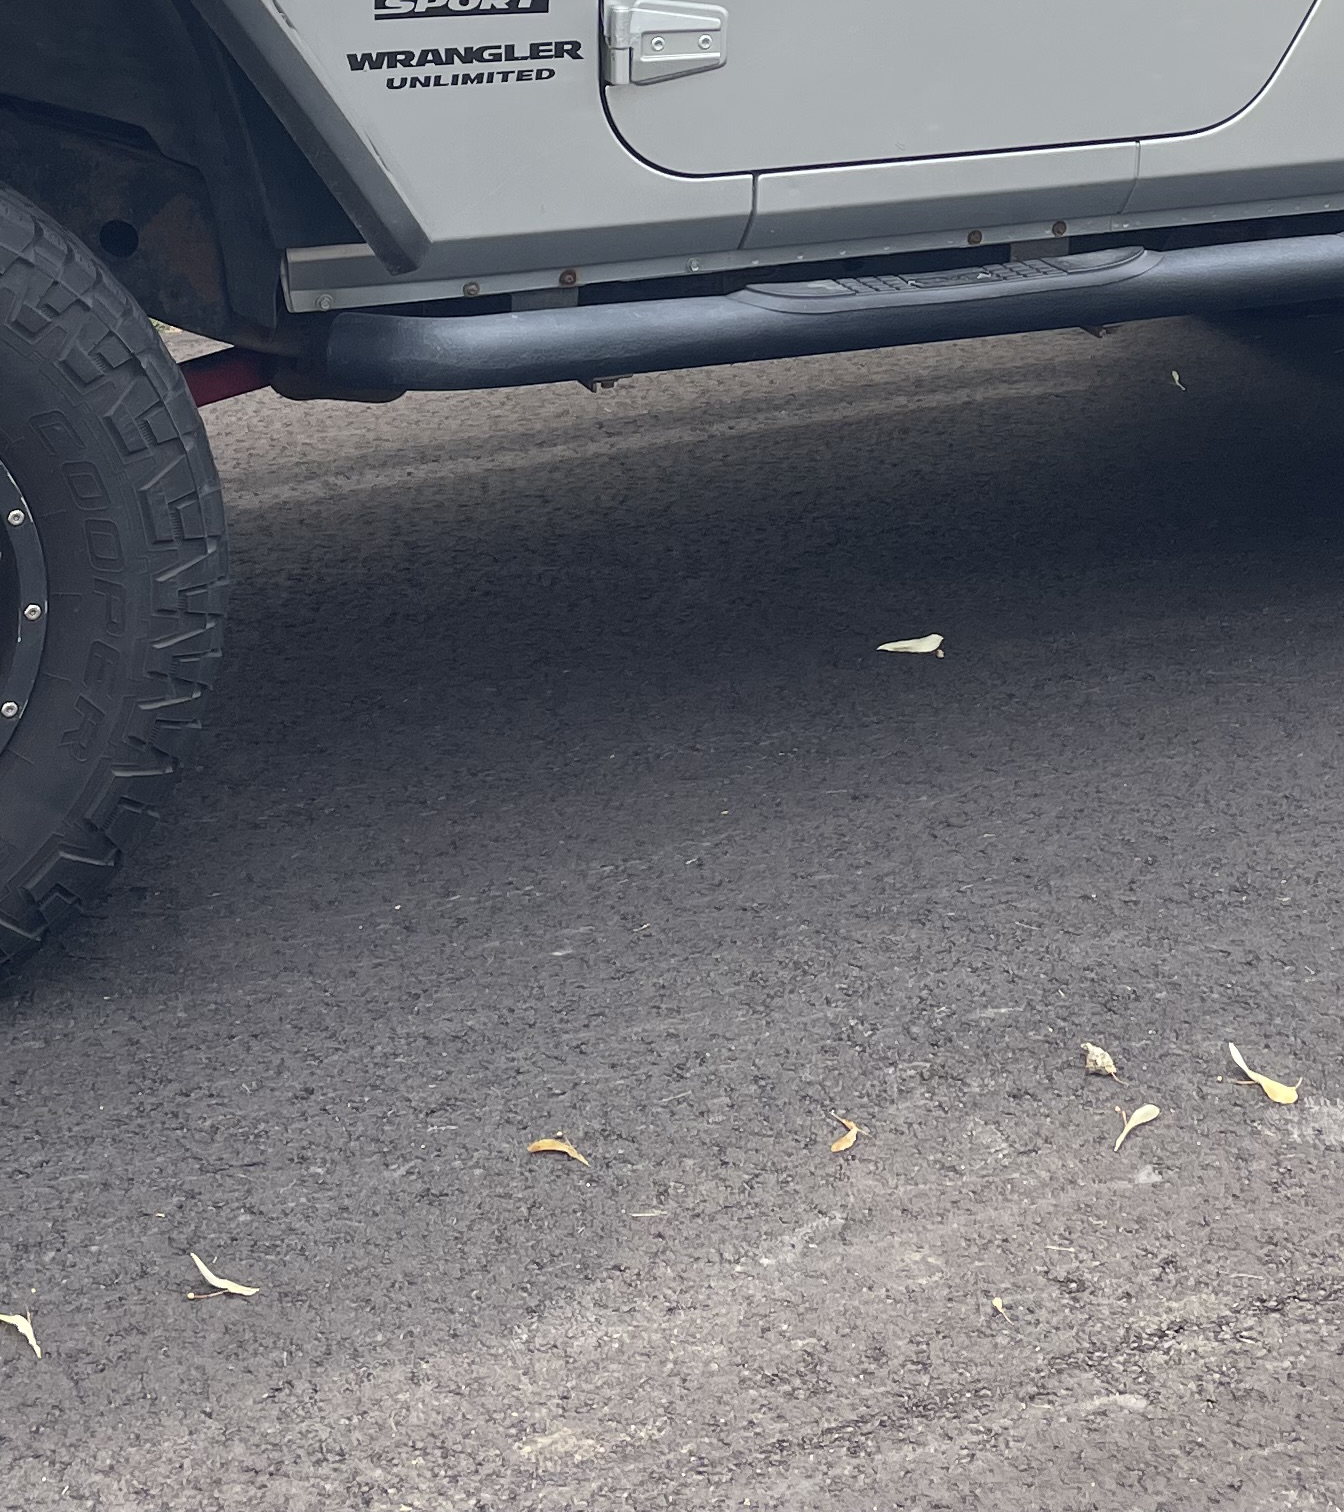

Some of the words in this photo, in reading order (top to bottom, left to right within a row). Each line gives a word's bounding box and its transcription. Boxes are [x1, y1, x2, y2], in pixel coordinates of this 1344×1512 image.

[346, 40, 585, 72] WRANGLER
[386, 67, 556, 90] UNLIMITED
[28, 409, 126, 762] COOPER
